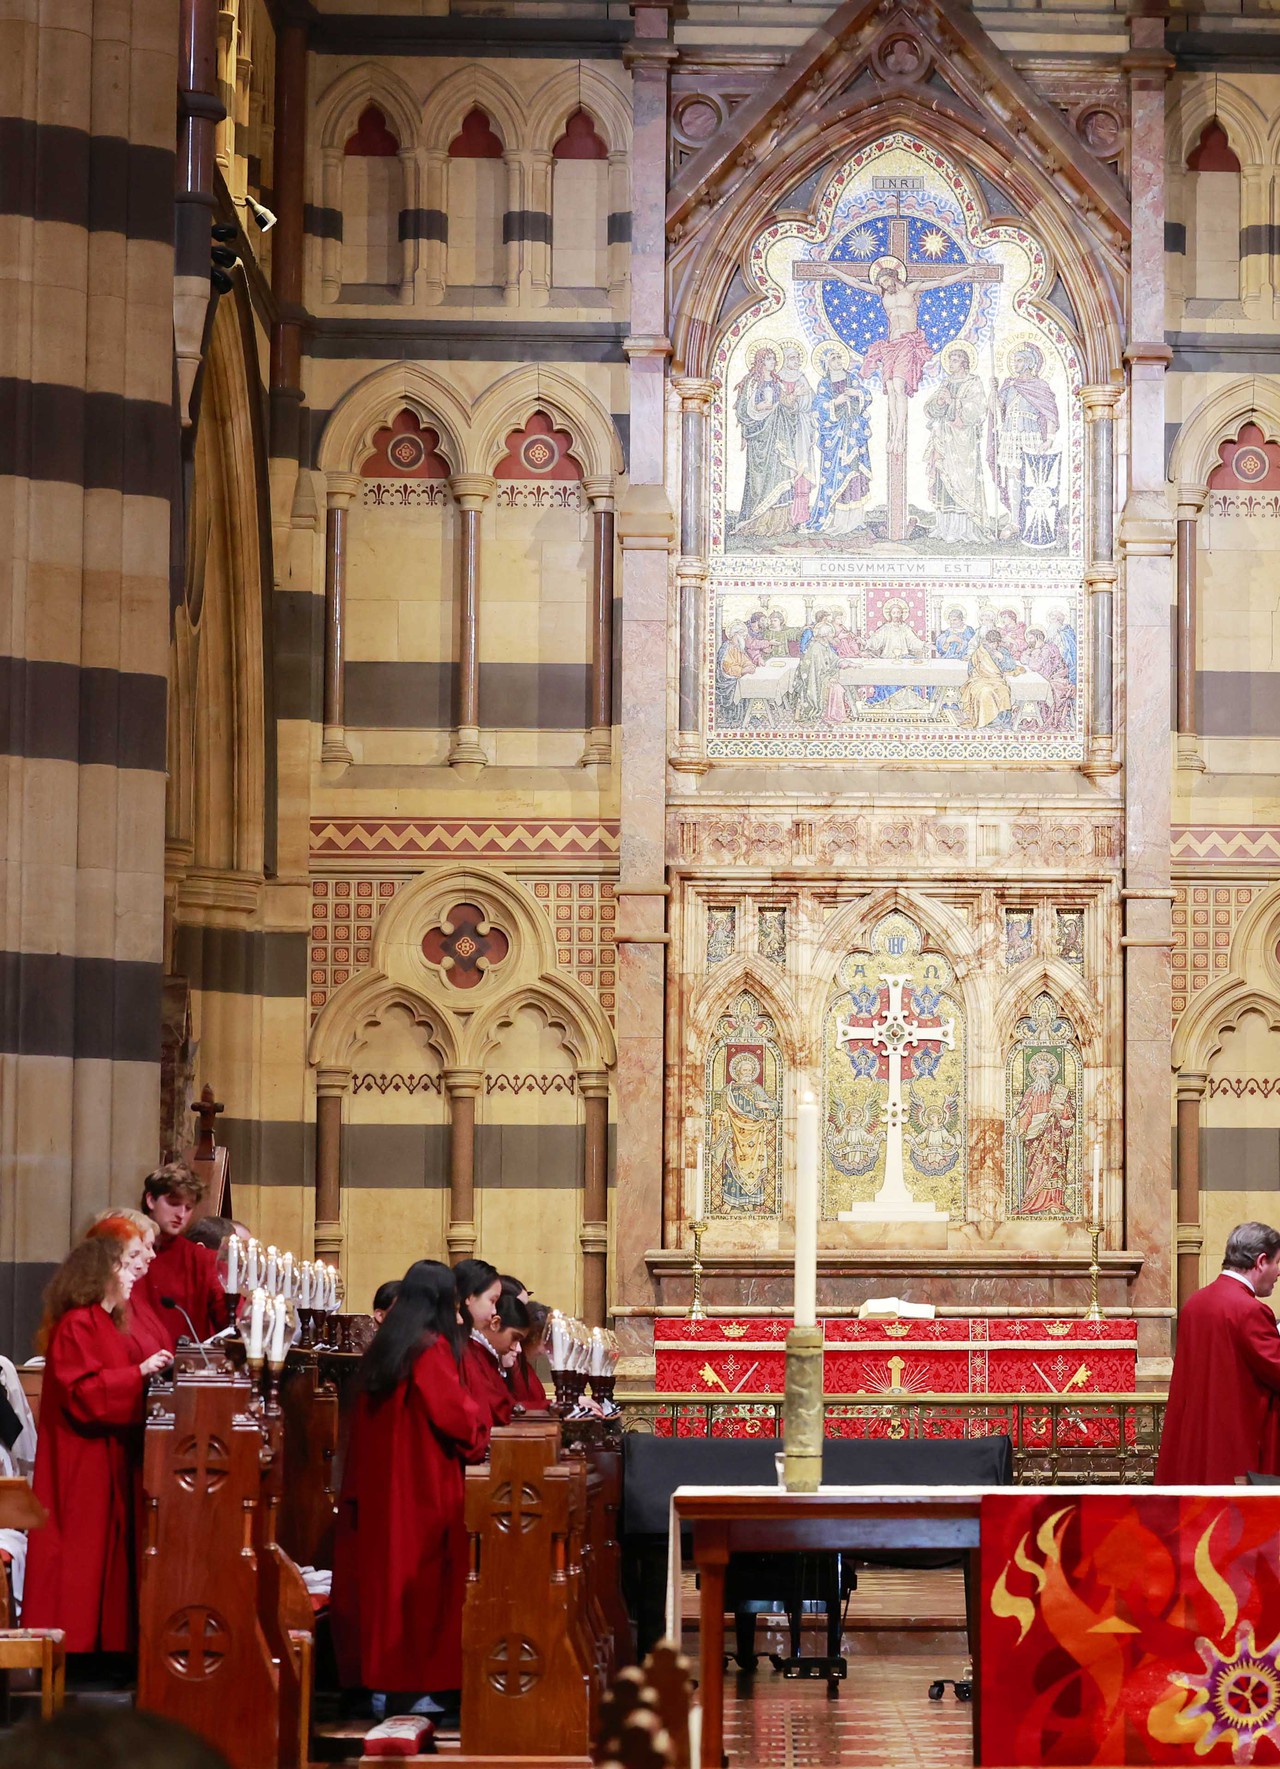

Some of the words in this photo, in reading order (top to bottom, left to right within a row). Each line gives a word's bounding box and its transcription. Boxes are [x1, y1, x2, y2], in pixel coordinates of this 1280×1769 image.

[882, 179, 915, 188] INRI
[820, 563, 926, 573] CONSVMMATVM
[944, 563, 973, 573] EST
[923, 965, 940, 979] Ω
